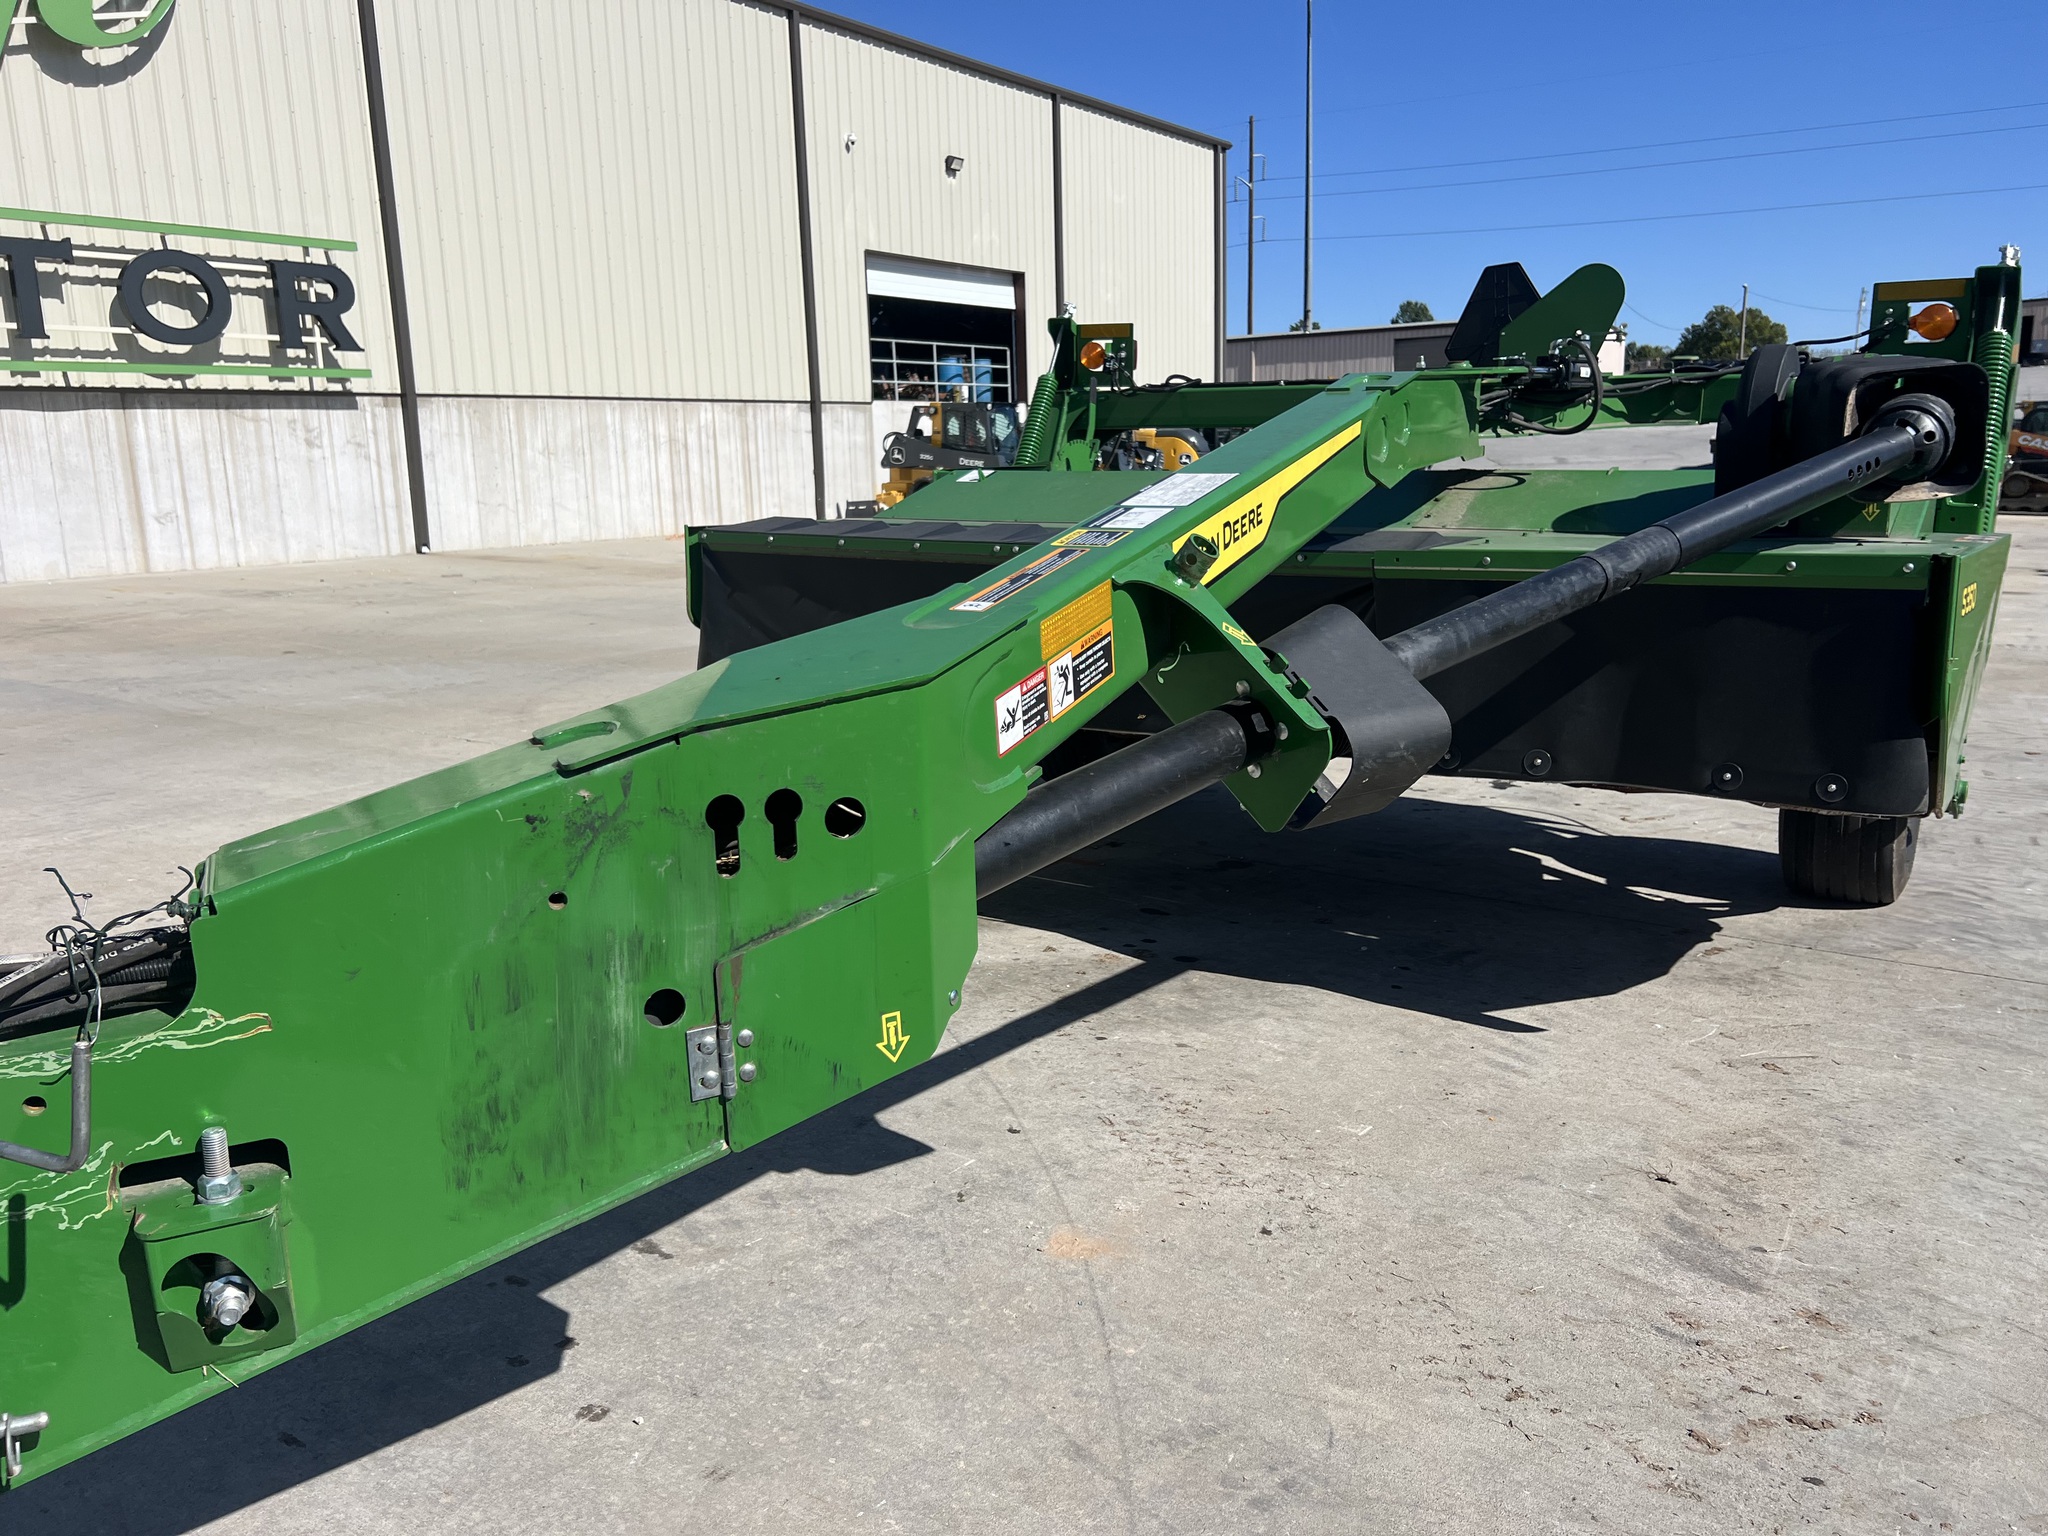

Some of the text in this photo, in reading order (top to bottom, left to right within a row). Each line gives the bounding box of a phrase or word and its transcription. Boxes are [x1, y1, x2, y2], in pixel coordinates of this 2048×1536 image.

[0, 237, 365, 352] TOR
[959, 457, 985, 468] DEERE
[1223, 502, 1263, 551] DEERE
[1027, 671, 1045, 689] DANGER
